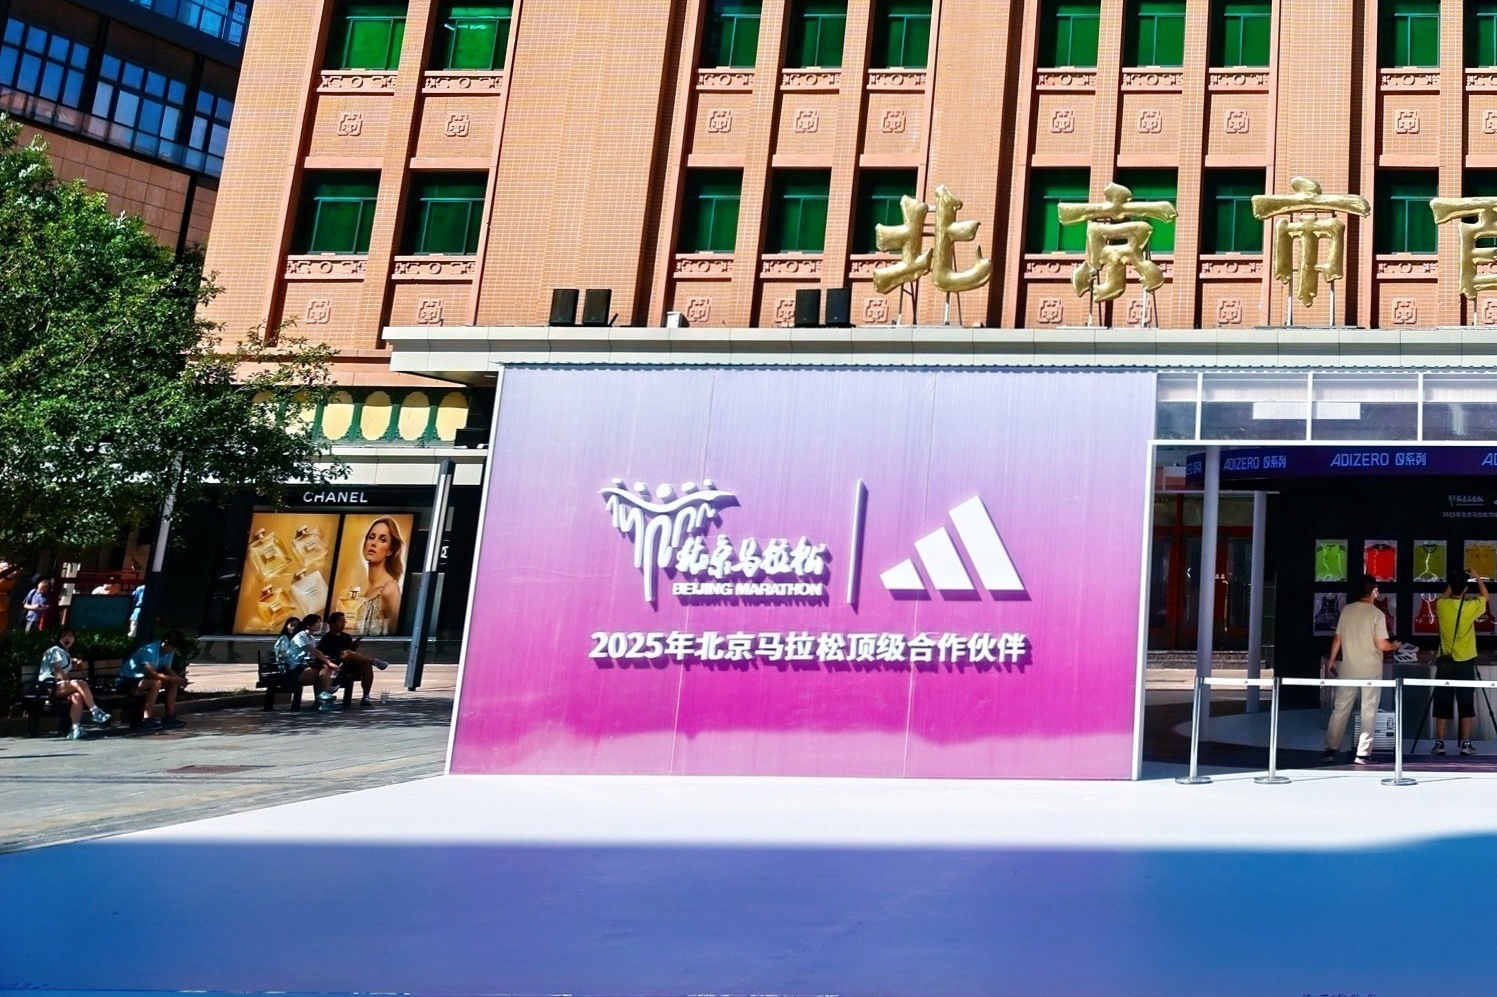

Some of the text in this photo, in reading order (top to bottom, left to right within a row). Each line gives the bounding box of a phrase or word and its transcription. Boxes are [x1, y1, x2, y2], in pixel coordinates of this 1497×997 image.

[1223, 457, 1260, 471] ADIZERO
[1329, 452, 1389, 467] ADIZERO
[302, 491, 368, 503] CHANEL
[672, 582, 822, 596] BEIJING MARATHON
[588, 631, 1027, 664] 2025年北京马拉松顶级合作伙伴
